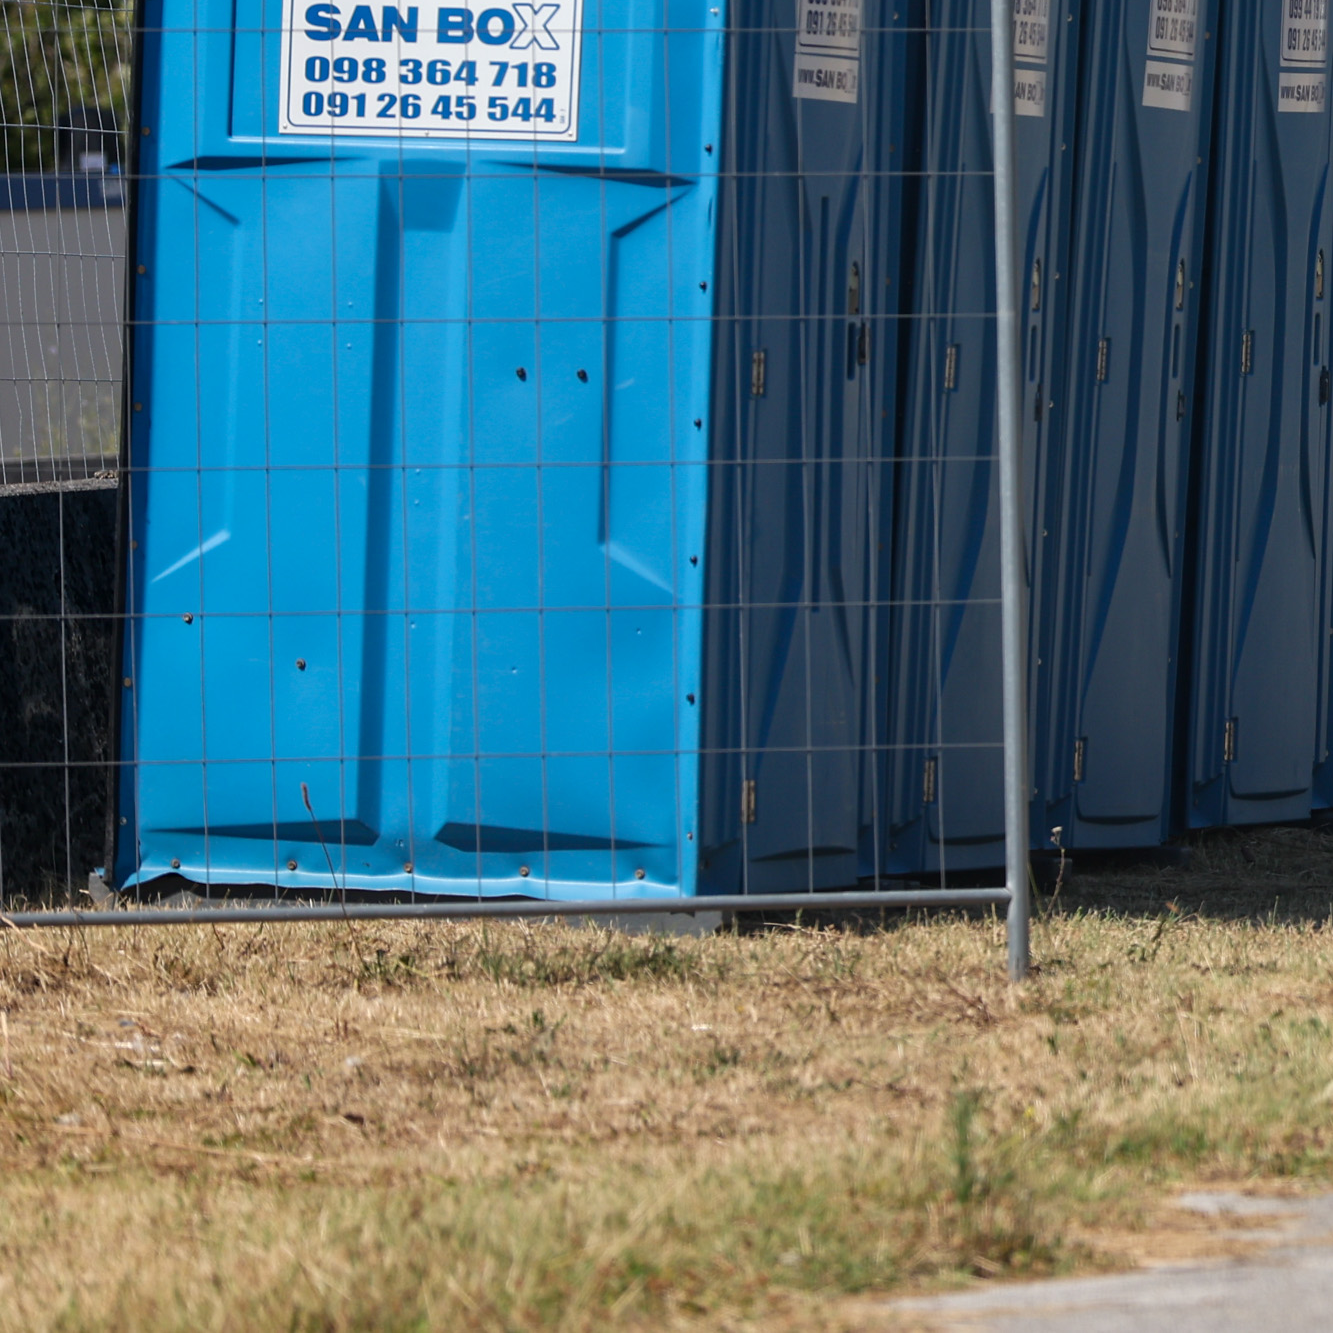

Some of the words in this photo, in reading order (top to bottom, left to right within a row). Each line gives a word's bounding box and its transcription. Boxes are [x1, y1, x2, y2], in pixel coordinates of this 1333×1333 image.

[304, 3, 419, 44] SAN
[436, 3, 561, 51] BOX
[1155, 16, 1168, 39] 091
[1288, 28, 1300, 50] 091
[305, 56, 386, 83] 098
[399, 59, 479, 85] 364
[489, 62, 556, 88] 718
[303, 92, 366, 117] 091
[377, 93, 422, 119] 26
[431, 95, 477, 120] 45
[488, 97, 556, 122] 544
